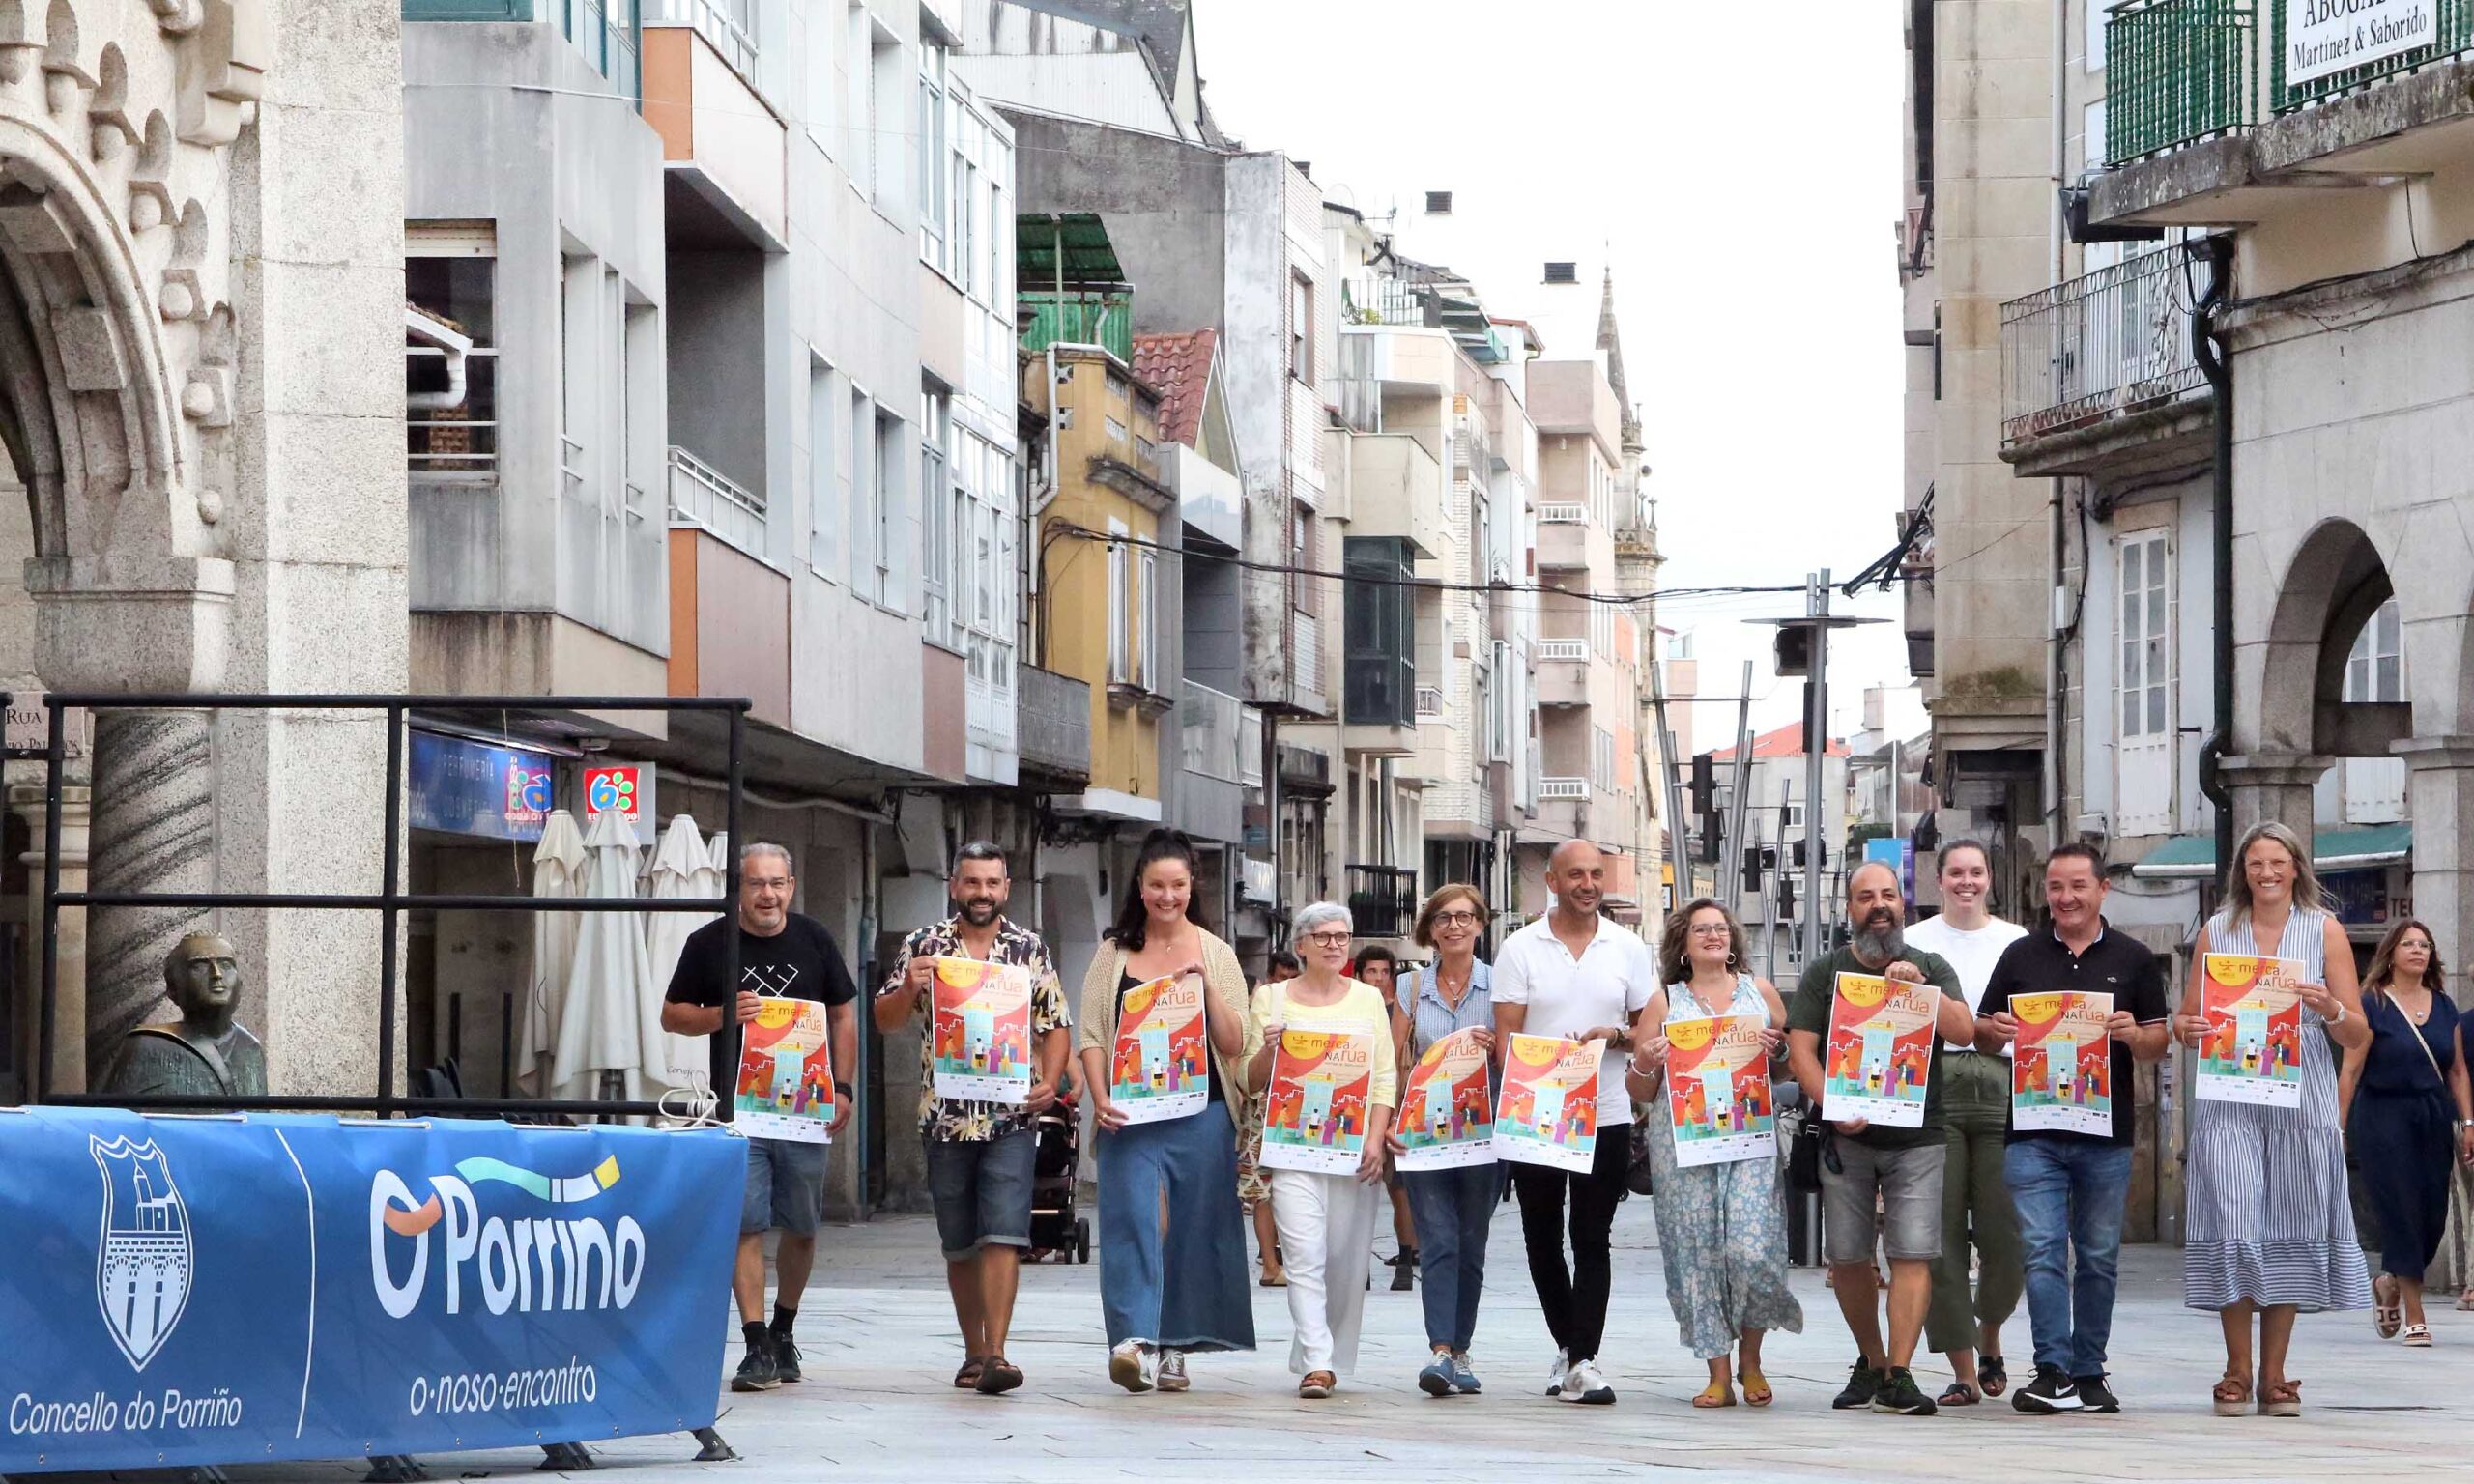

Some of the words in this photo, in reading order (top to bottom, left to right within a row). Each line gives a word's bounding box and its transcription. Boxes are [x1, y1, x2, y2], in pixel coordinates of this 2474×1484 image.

[2293, 34, 2350, 71] Martínez
[2354, 25, 2365, 52] &
[2369, 4, 2428, 47] Saborido
[2304, 0, 2386, 28] ABOG
[9, 1391, 118, 1435] Concello
[124, 1390, 155, 1430] do
[159, 1387, 242, 1429] Porriño
